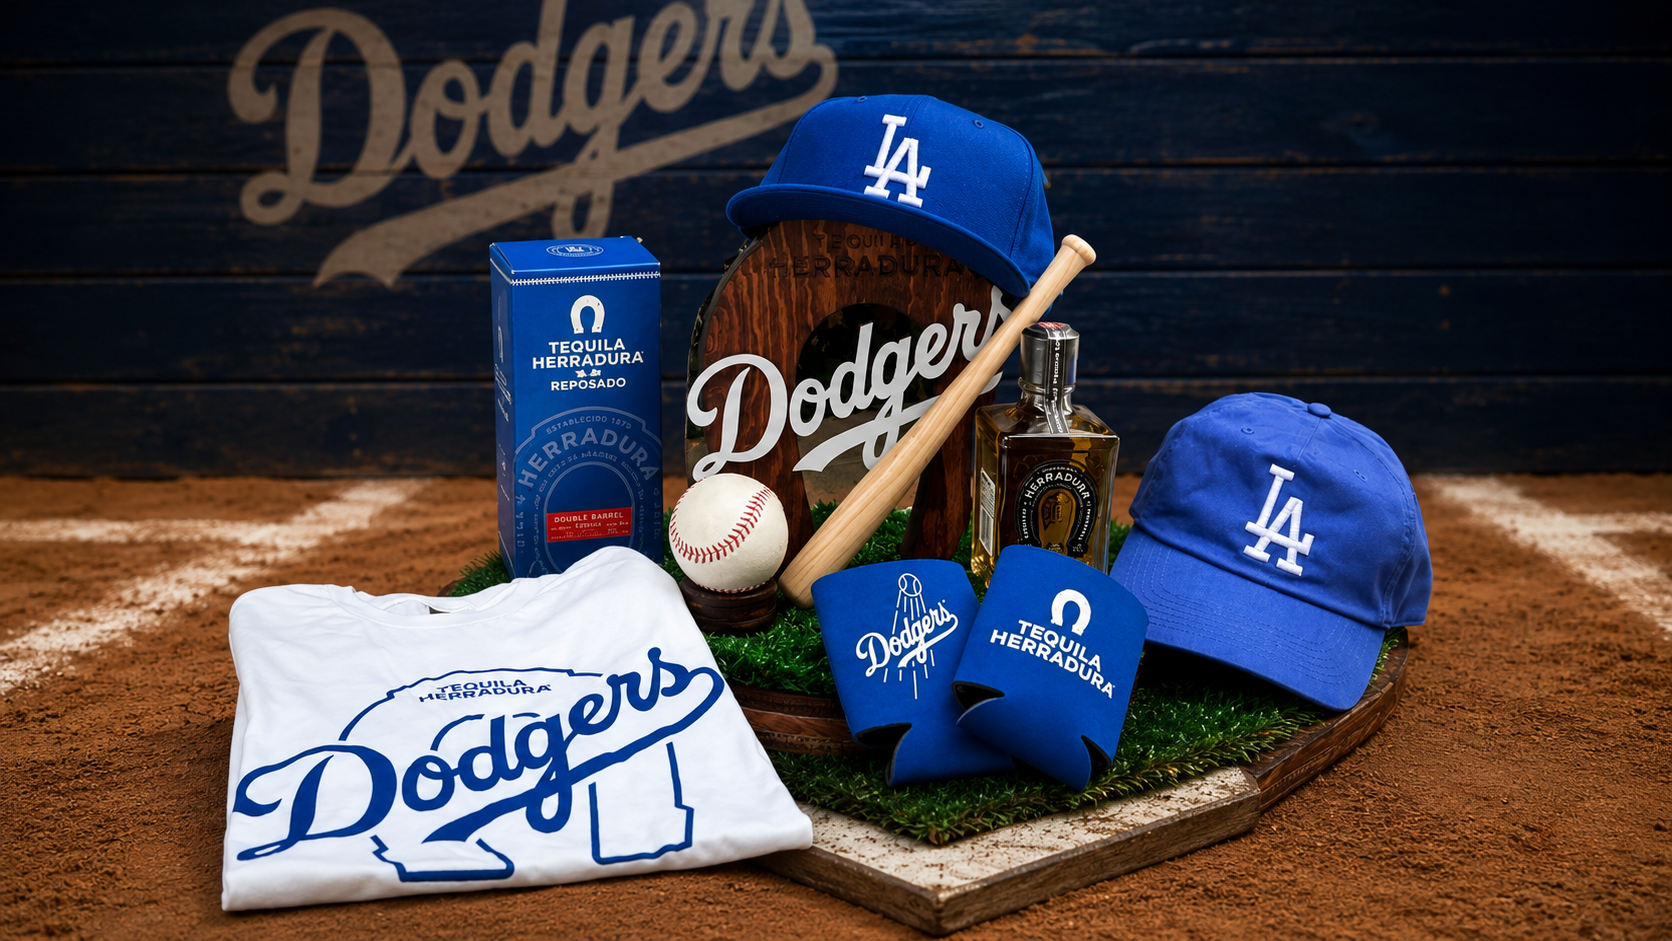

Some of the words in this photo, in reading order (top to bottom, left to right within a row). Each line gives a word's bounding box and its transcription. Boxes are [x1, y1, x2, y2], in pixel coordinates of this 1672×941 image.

[227, 0, 838, 287] Dodgers
[863, 113, 932, 208] LA
[532, 351, 644, 369] HERRADURA
[548, 338, 626, 354] TEQUILA
[550, 377, 626, 391] REPOSADO
[518, 427, 660, 489] HERRADURA
[1024, 471, 1091, 500] HERRADURA
[554, 514, 588, 523] DOUBLE
[591, 511, 624, 520] BARREL
[1243, 463, 1315, 577] LA
[855, 600, 959, 677] Dodgers
[989, 629, 1116, 699] HERRADURA
[1018, 619, 1102, 672] TEQUILA
[418, 683, 552, 703] HERRADURA
[436, 679, 527, 693] TEQUILA
[232, 646, 725, 861] Dodgers
